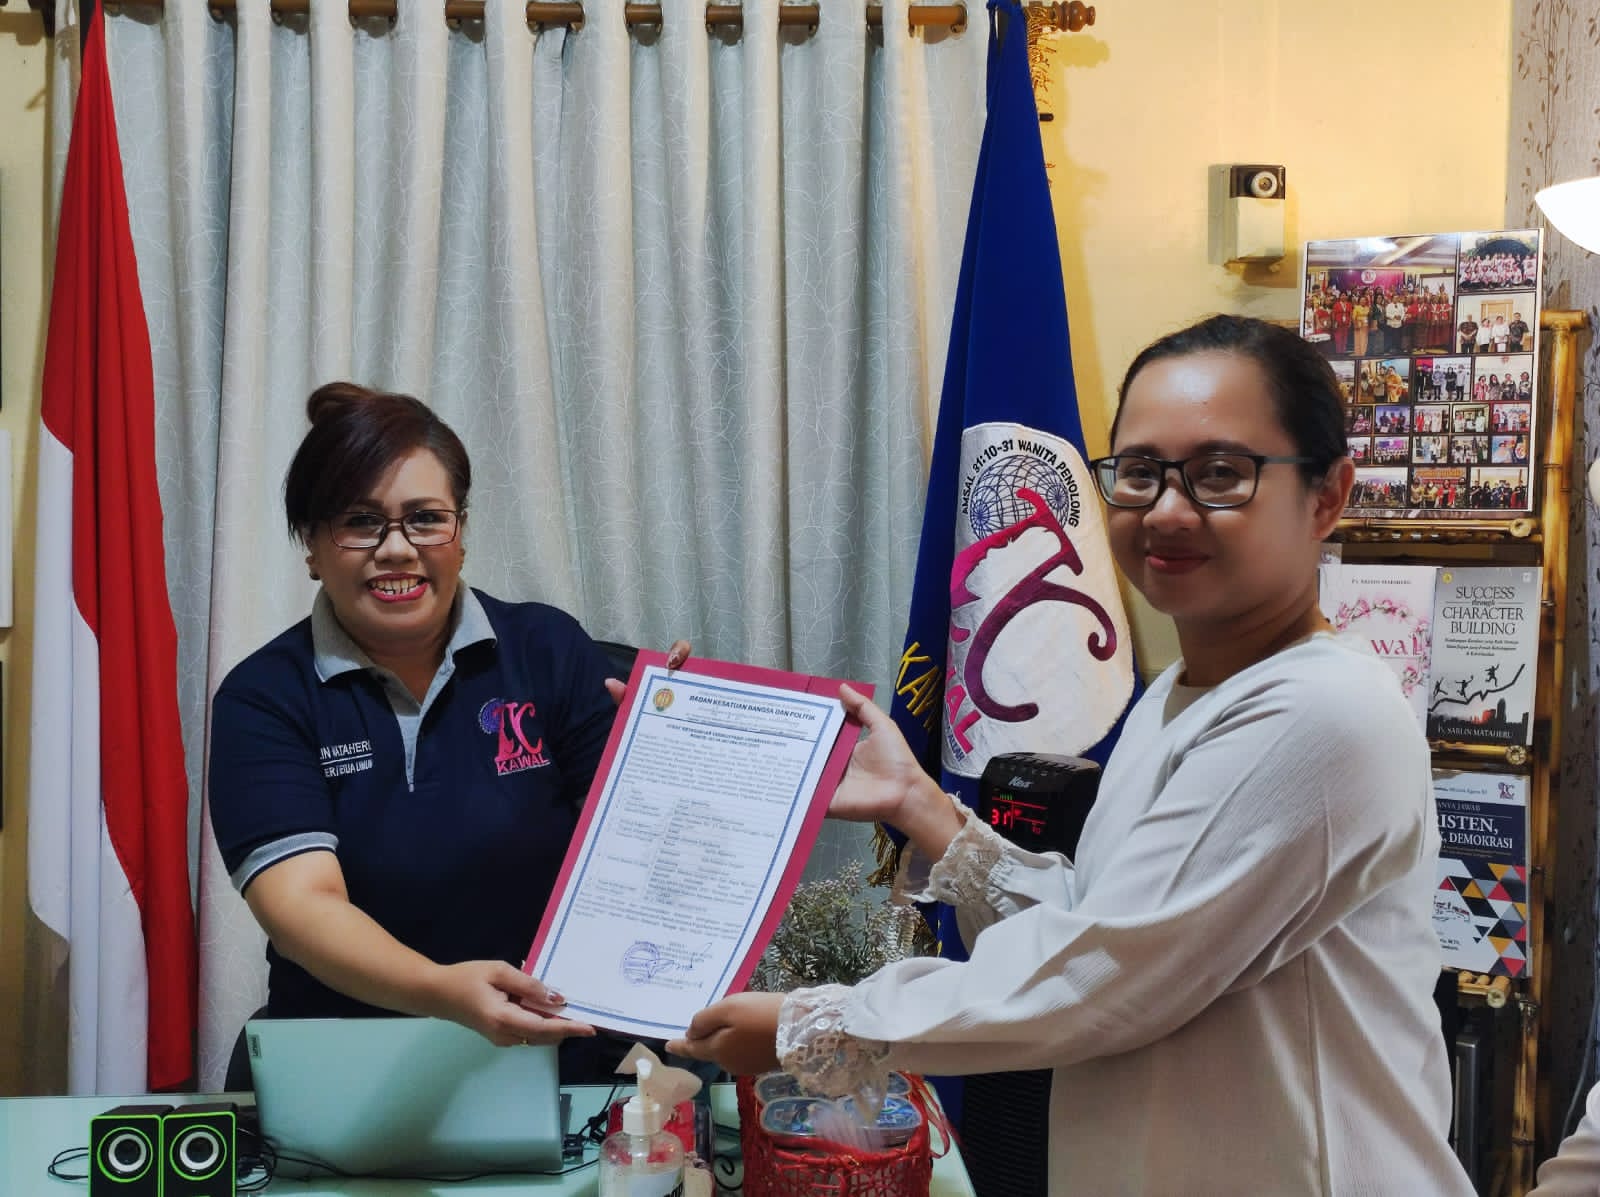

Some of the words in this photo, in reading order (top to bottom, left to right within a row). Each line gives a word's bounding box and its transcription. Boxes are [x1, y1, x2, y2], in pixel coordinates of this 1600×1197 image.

[961, 474, 977, 515] AMSAL
[972, 438, 1014, 474] 31:10-31
[1017, 439, 1058, 467] WANITA
[1054, 461, 1082, 528] PENOLONG
[1455, 586, 1516, 600] SUCCESS
[1442, 606, 1525, 621] CHARACTER
[1450, 621, 1516, 635] BUILDING
[789, 710, 817, 721] POLITIK
[496, 753, 550, 774] KAWAL
[1438, 814, 1499, 835] ISTEN,
[1449, 832, 1513, 849] DEMOKRASI
